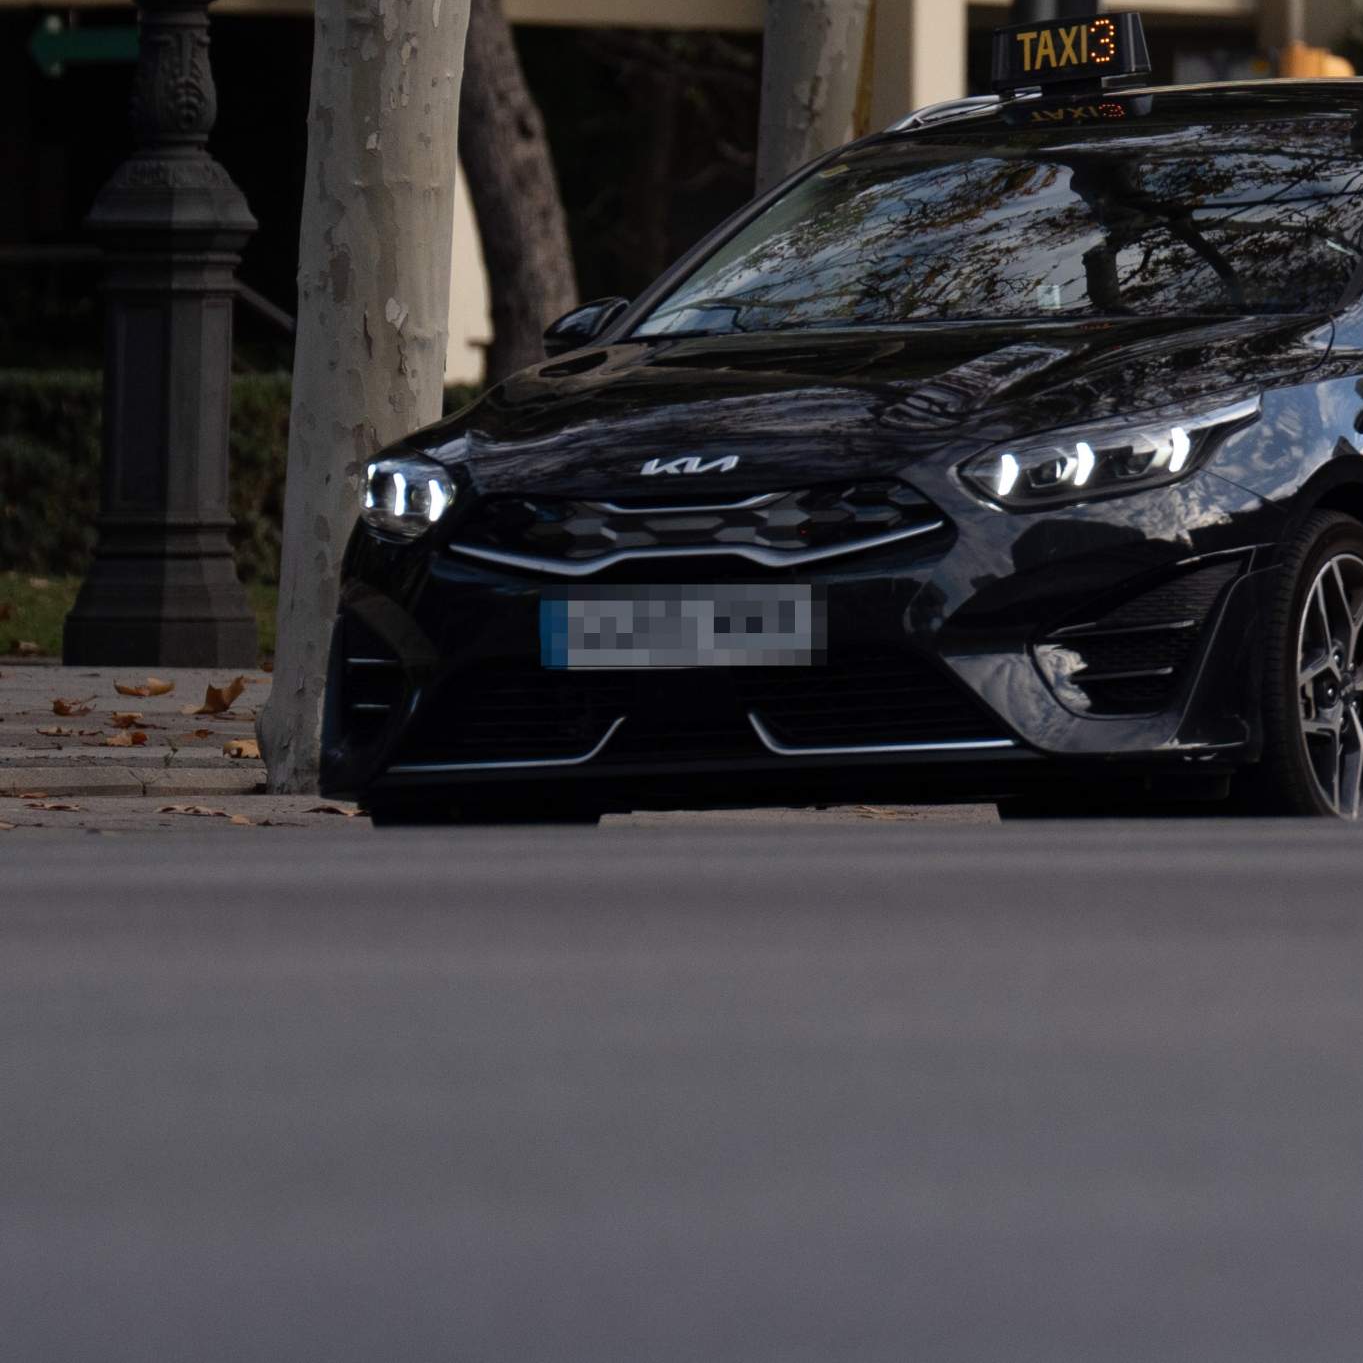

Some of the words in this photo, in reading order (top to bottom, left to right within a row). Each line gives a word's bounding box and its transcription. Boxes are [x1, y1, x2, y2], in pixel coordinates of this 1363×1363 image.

[1016, 24, 1088, 72] TAXI
[1090, 19, 1116, 64] 3
[640, 455, 740, 476] KIA
